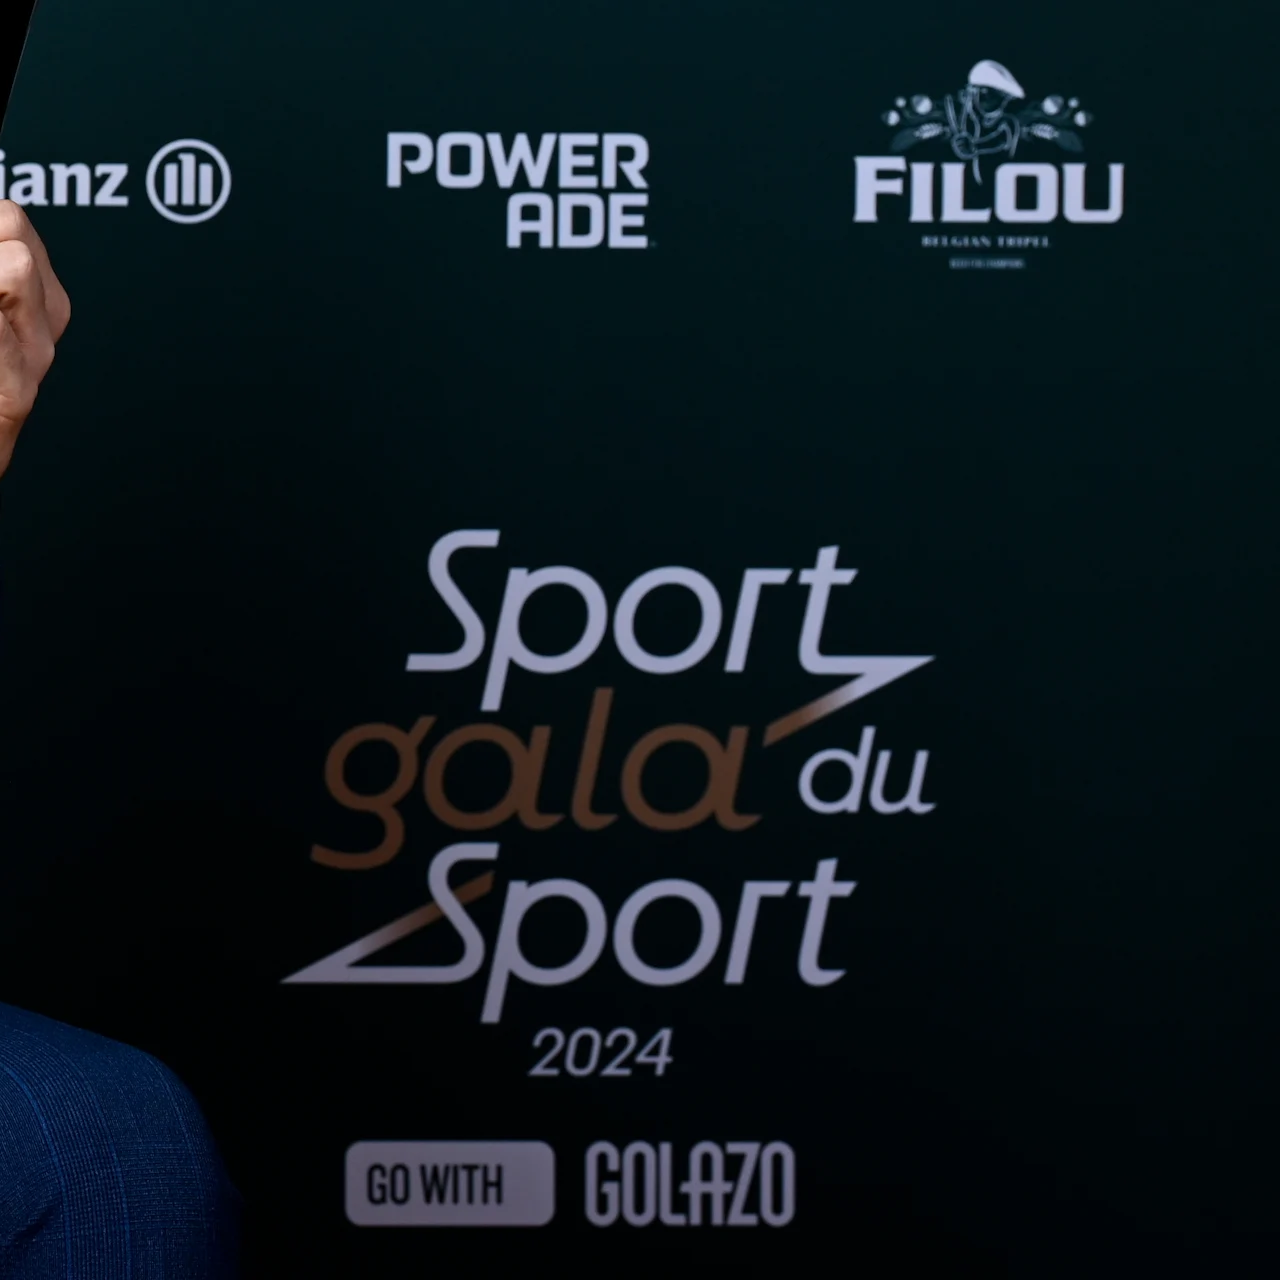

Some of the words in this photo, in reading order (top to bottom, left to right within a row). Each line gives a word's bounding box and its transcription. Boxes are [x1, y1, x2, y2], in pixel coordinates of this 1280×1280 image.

[387, 132, 649, 189] POWER
[853, 156, 1124, 223] FILOU
[507, 192, 648, 248] ADE
[406, 529, 936, 711] Sport
[312, 690, 758, 868] gala
[798, 728, 935, 814] du
[279, 842, 858, 1024] Sport
[530, 1028, 672, 1076] 2024
[367, 1163, 410, 1206] GO
[419, 1164, 503, 1205] WITH
[585, 1141, 795, 1227] GOLAZO
